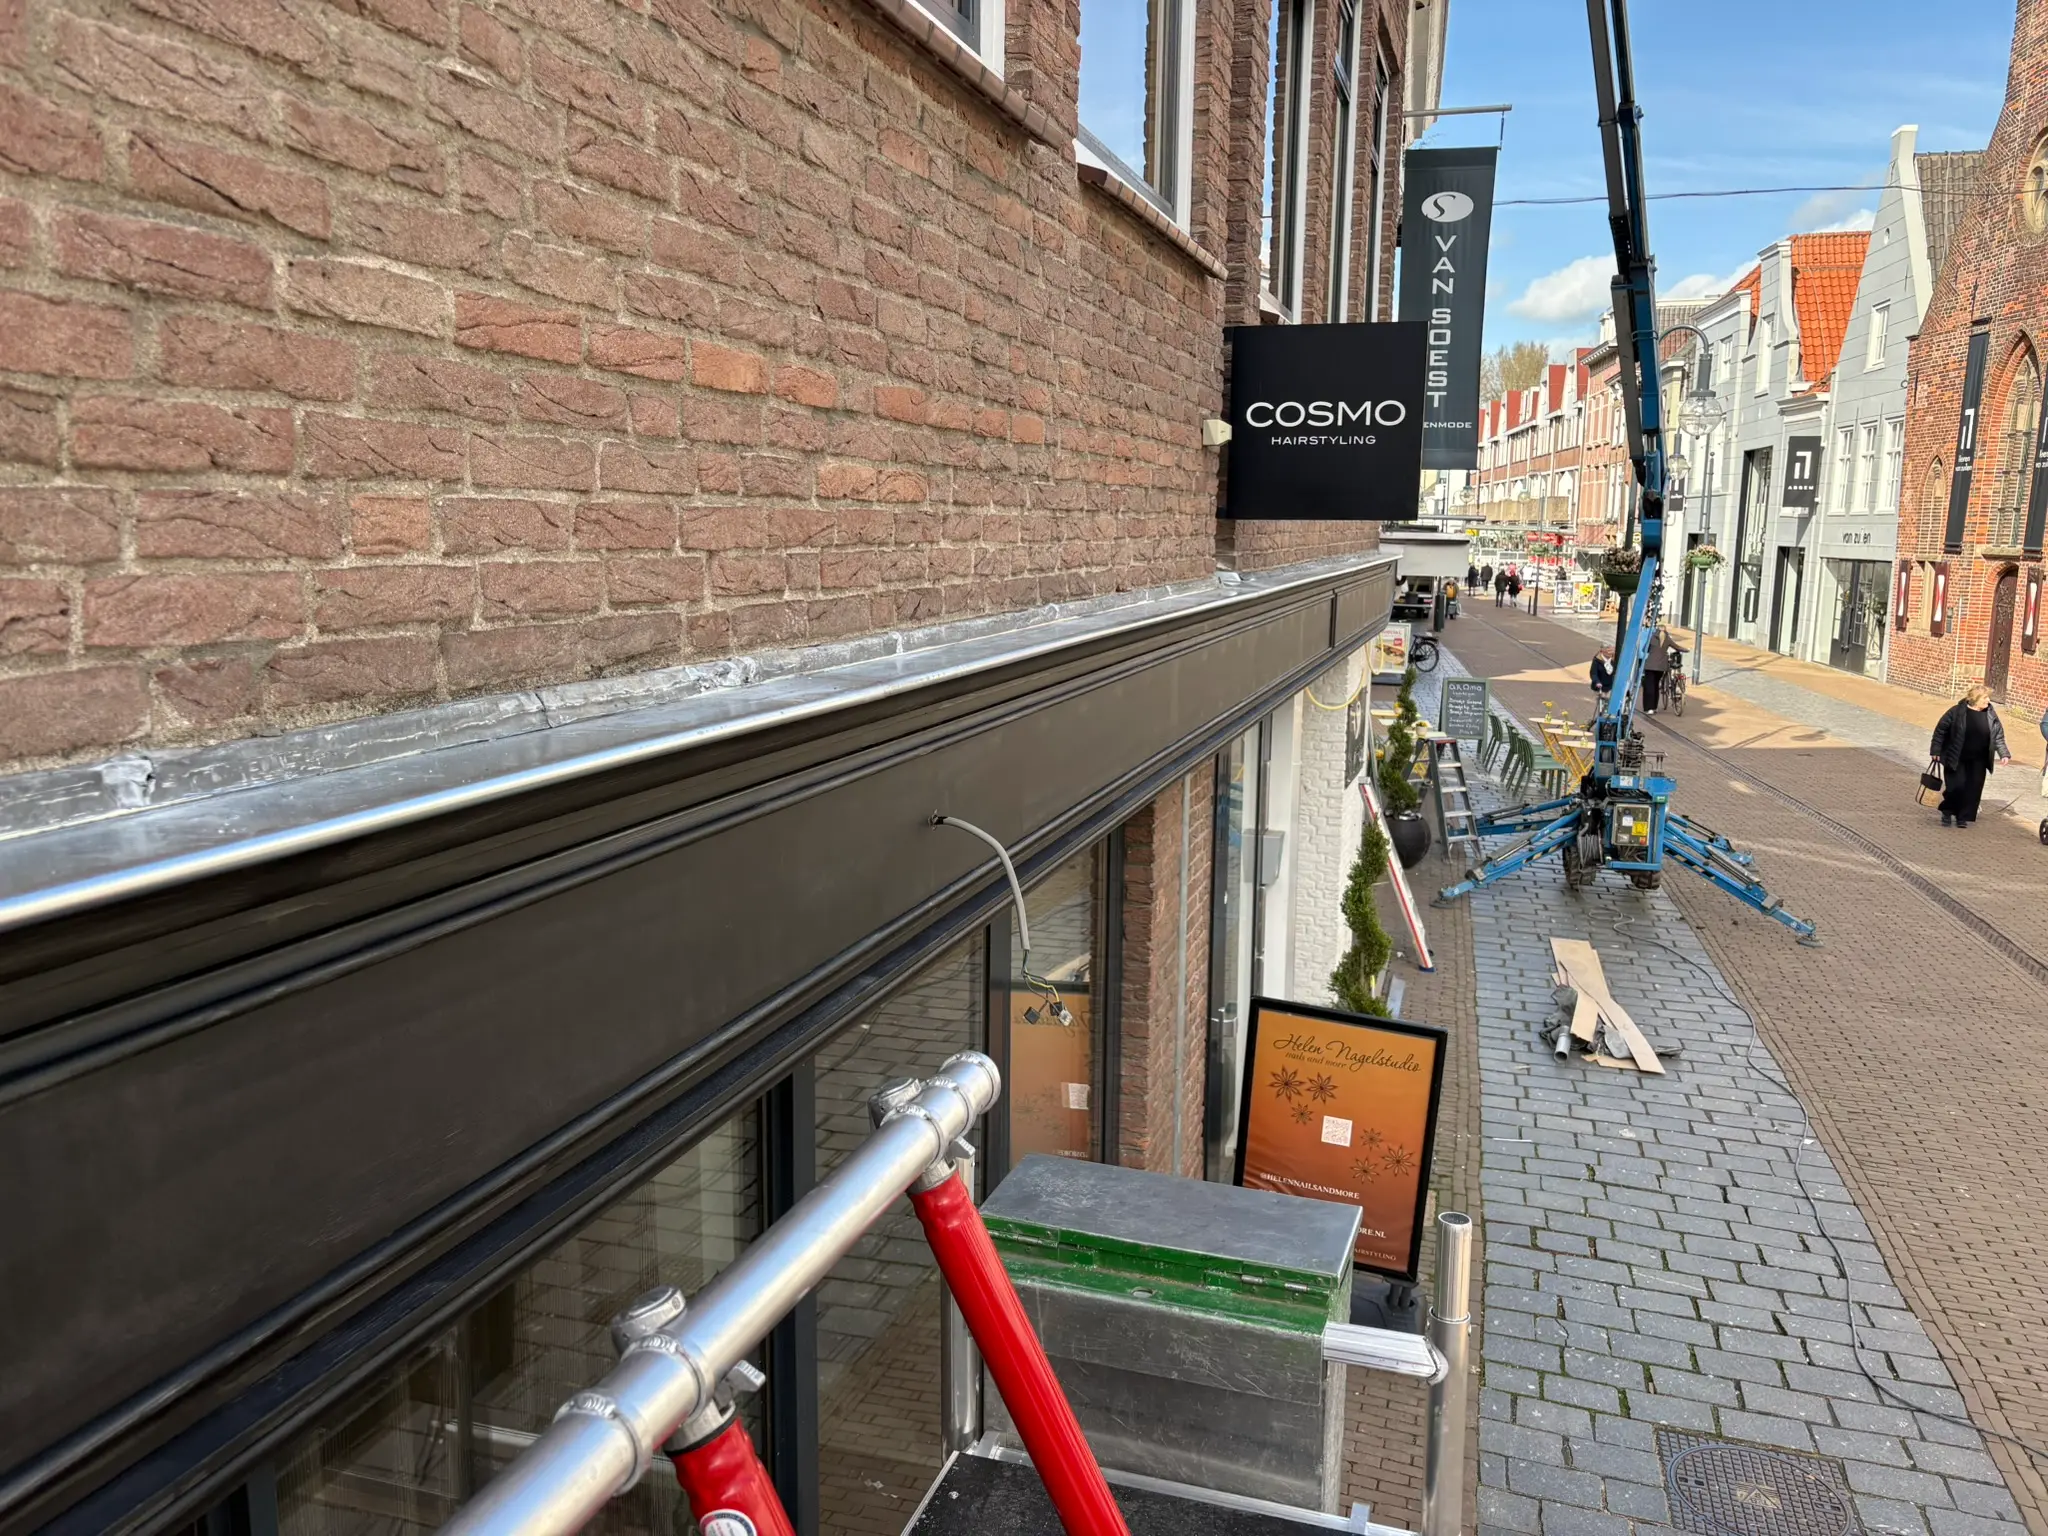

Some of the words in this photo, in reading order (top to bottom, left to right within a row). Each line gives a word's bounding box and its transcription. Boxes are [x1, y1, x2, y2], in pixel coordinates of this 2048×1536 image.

[1431, 235, 1457, 295] VAN
[1426, 308, 1451, 408] SOEST
[1245, 399, 1407, 428] COSMO
[1271, 435, 1377, 446] HAIRSTYLING
[1853, 528, 1872, 545] zuen
[1273, 1033, 1323, 1055] Helen
[1325, 1040, 1422, 1073] Nagelstudio
[1285, 1051, 1305, 1061] nails
[1306, 1054, 1323, 1065] and
[1325, 1059, 1347, 1068] more
[1260, 1172, 1361, 1199] @HELENNAILSANDMORE
